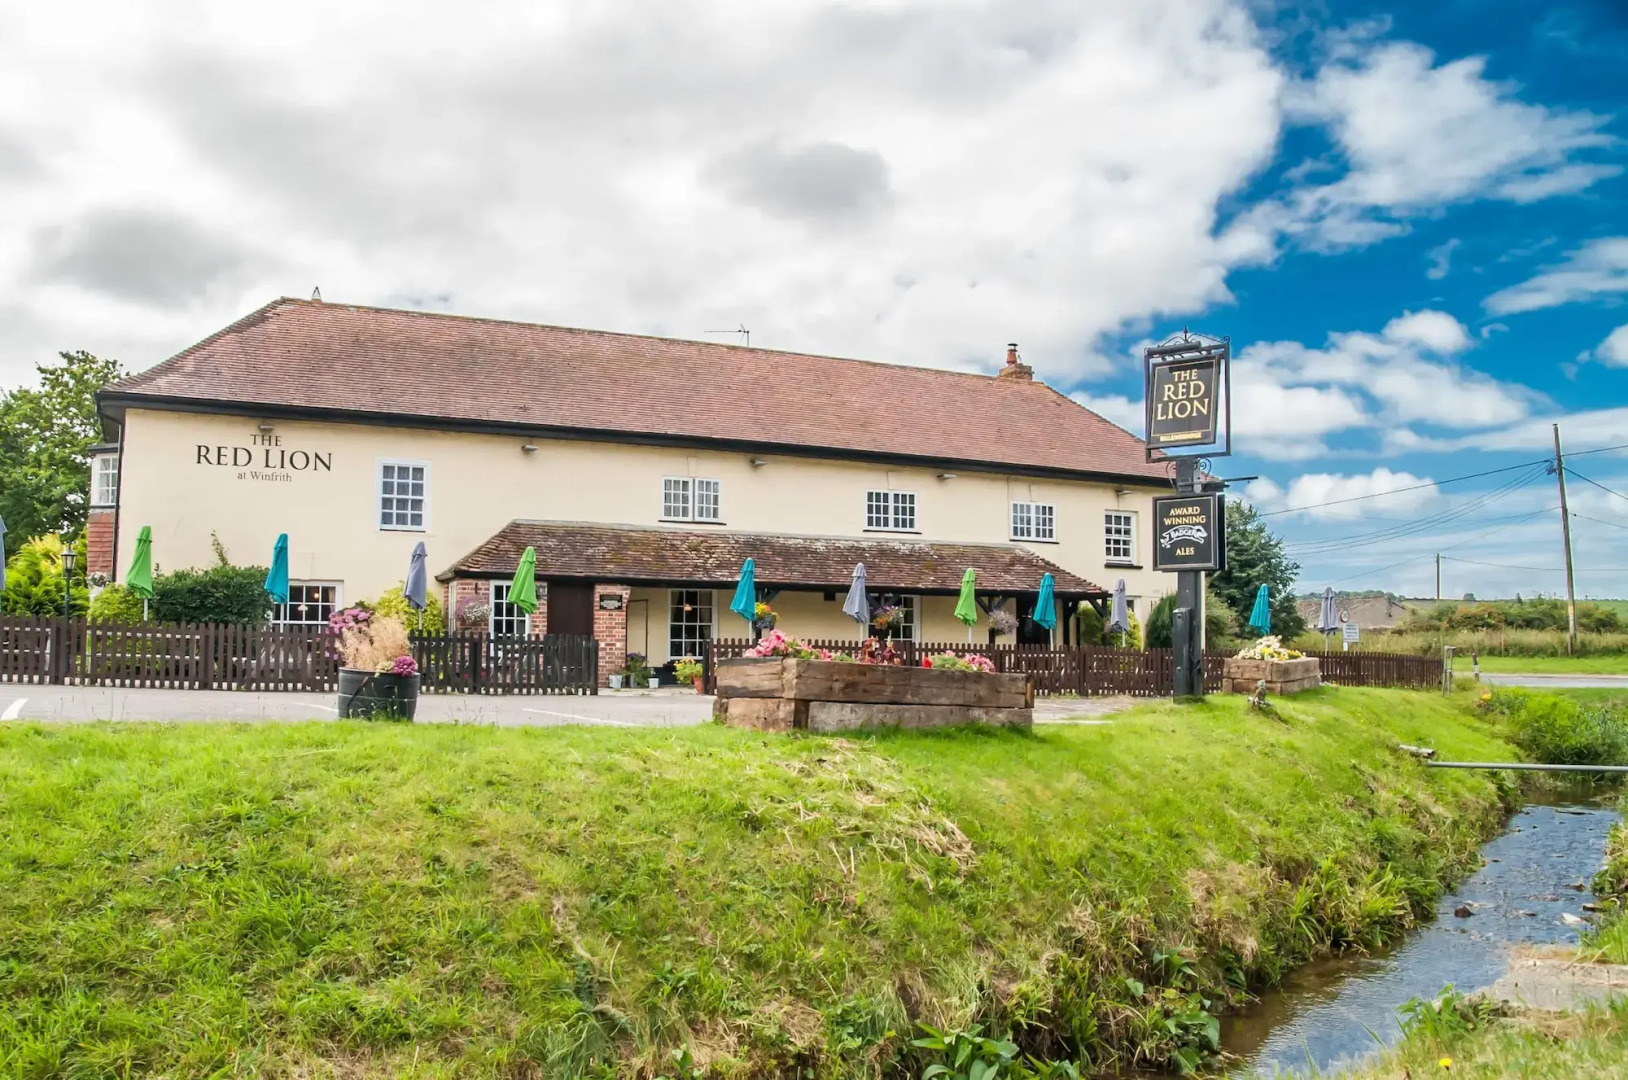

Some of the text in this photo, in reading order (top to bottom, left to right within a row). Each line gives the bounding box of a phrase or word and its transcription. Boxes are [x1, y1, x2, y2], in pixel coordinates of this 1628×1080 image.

[1172, 369, 1198, 382] THE
[1163, 380, 1205, 401] RED
[1157, 398, 1209, 421] LION
[250, 434, 282, 447] THE
[196, 444, 332, 472] RED LION
[237, 471, 292, 482] at Winfrith
[1169, 506, 1201, 516] AWARD
[1164, 515, 1206, 525] WINNING
[1170, 529, 1198, 539] BADGER
[1175, 547, 1195, 555] ALES
